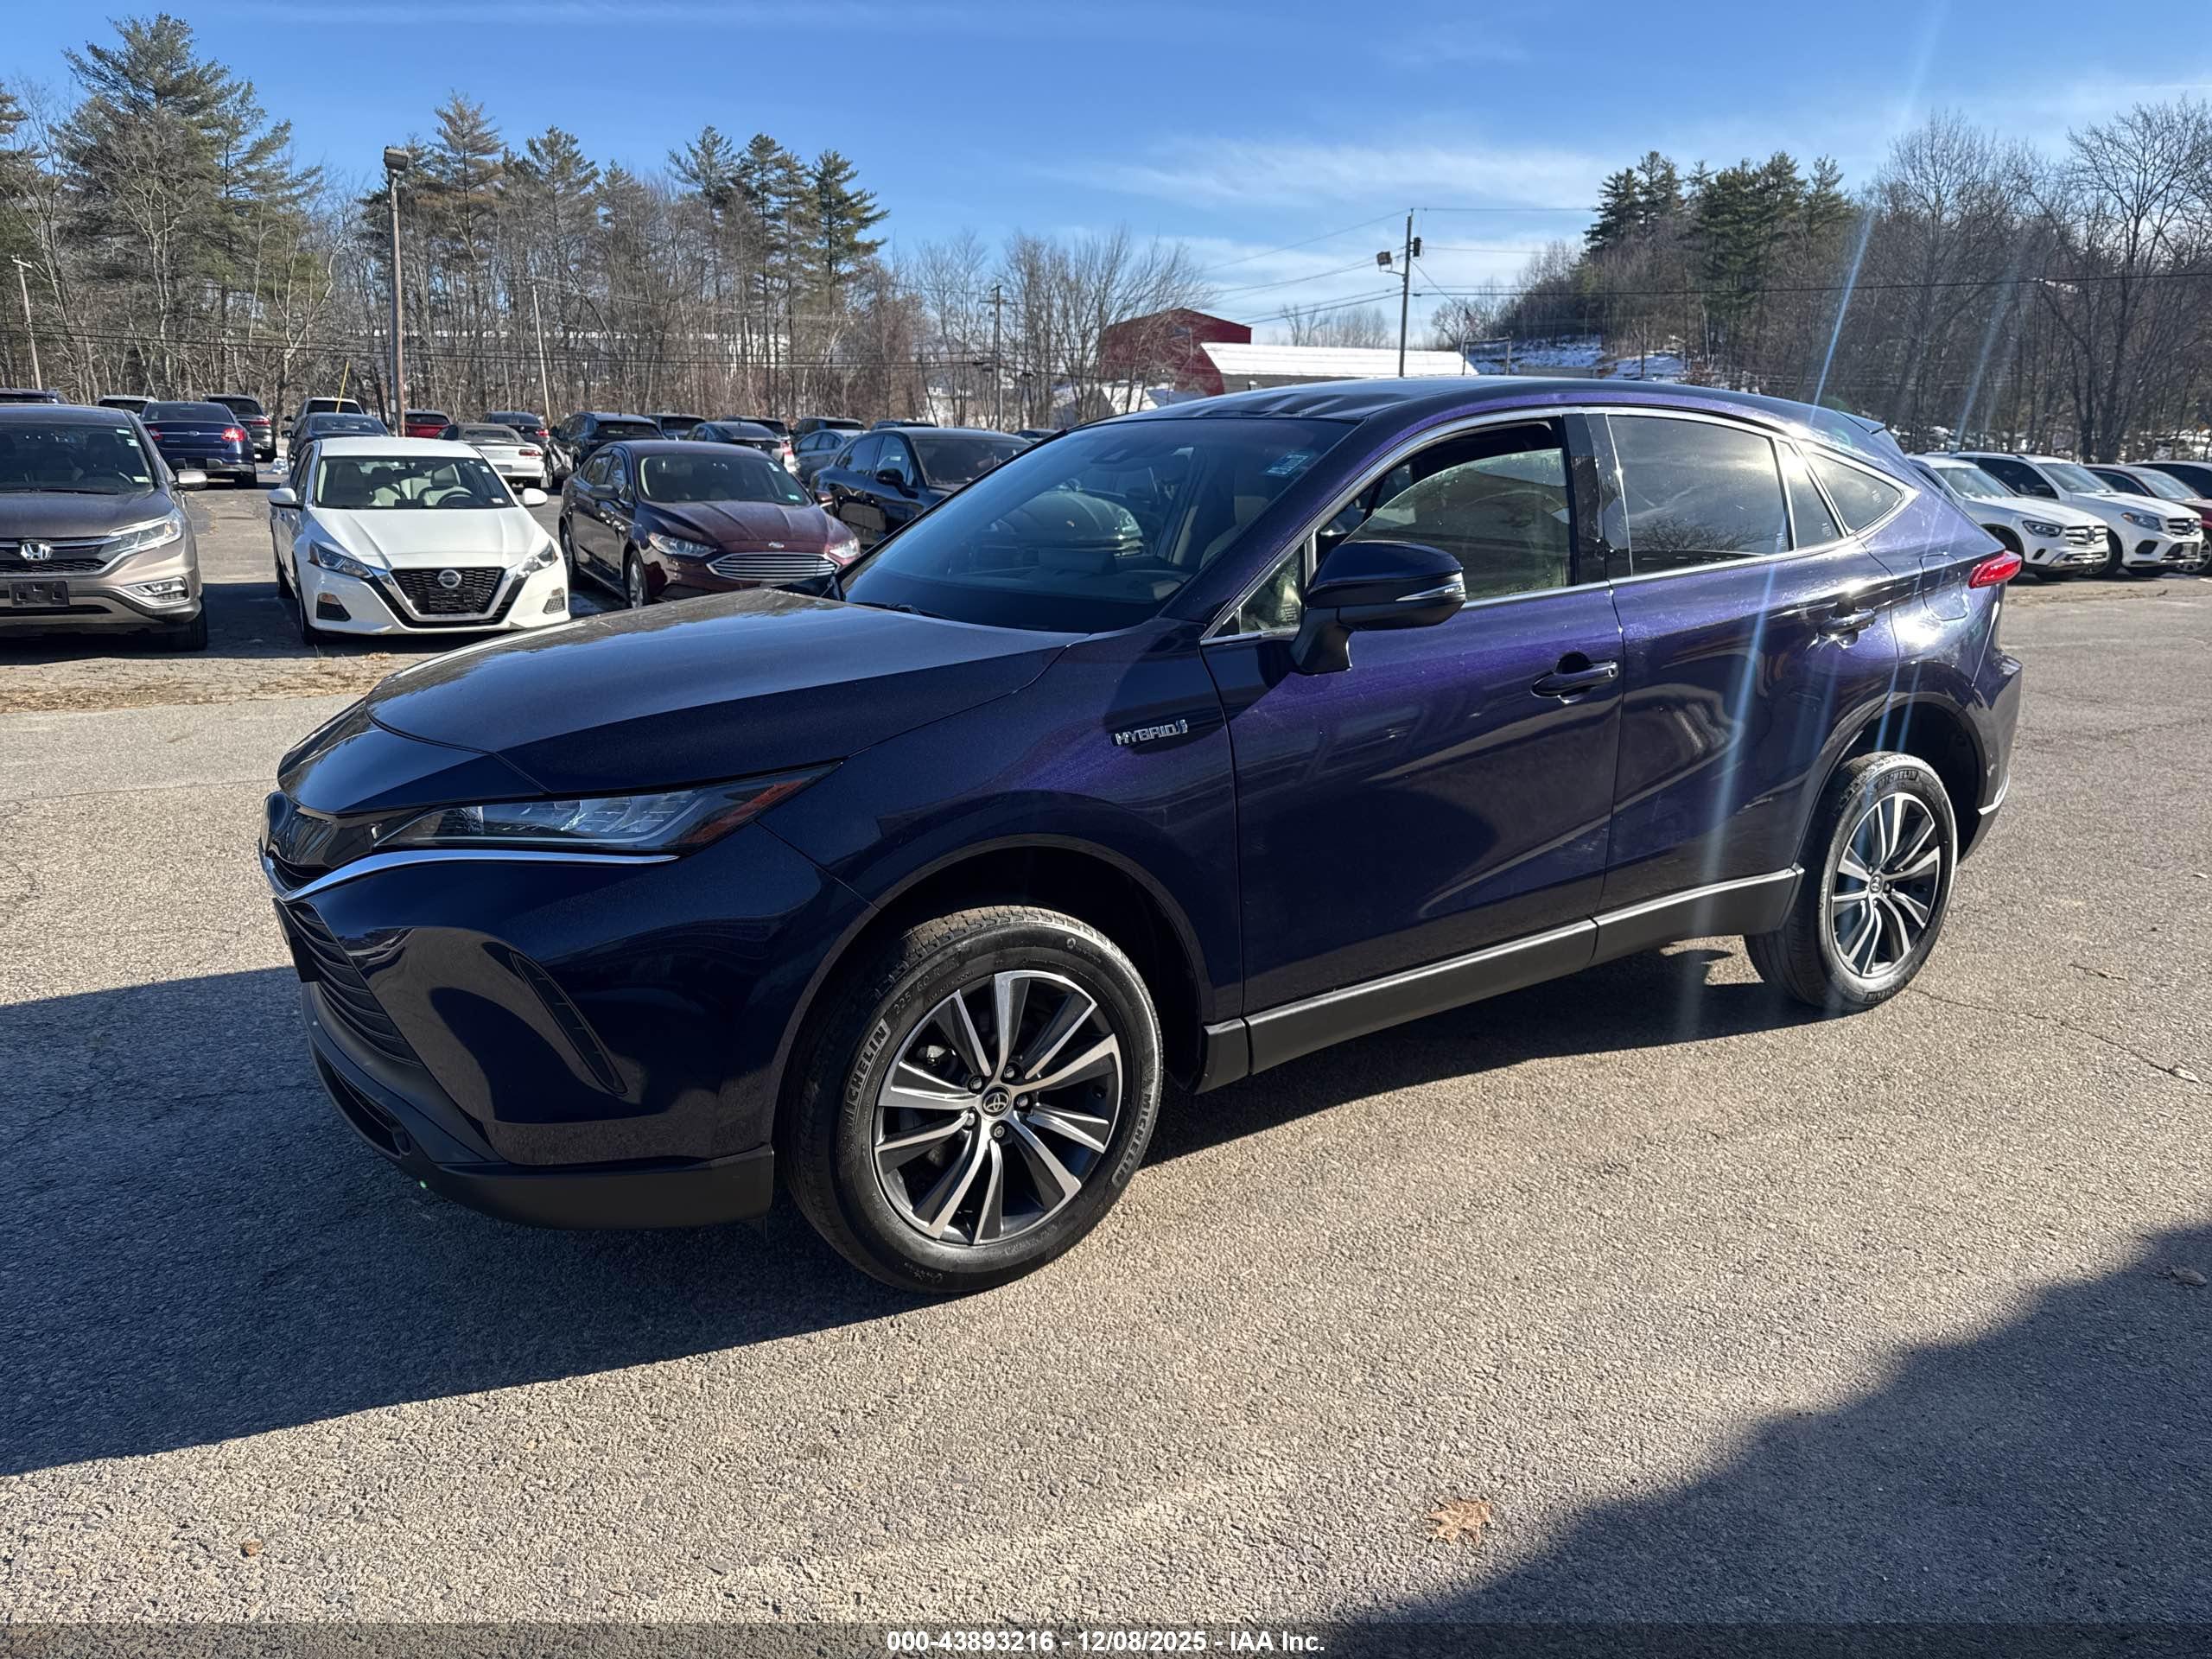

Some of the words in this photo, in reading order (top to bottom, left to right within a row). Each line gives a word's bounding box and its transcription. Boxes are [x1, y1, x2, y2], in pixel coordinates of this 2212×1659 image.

[1115, 723, 1179, 746] HYBRID
[842, 1026, 887, 1129] MICHELIN
[1115, 1093, 1153, 1185] MICHELIN
